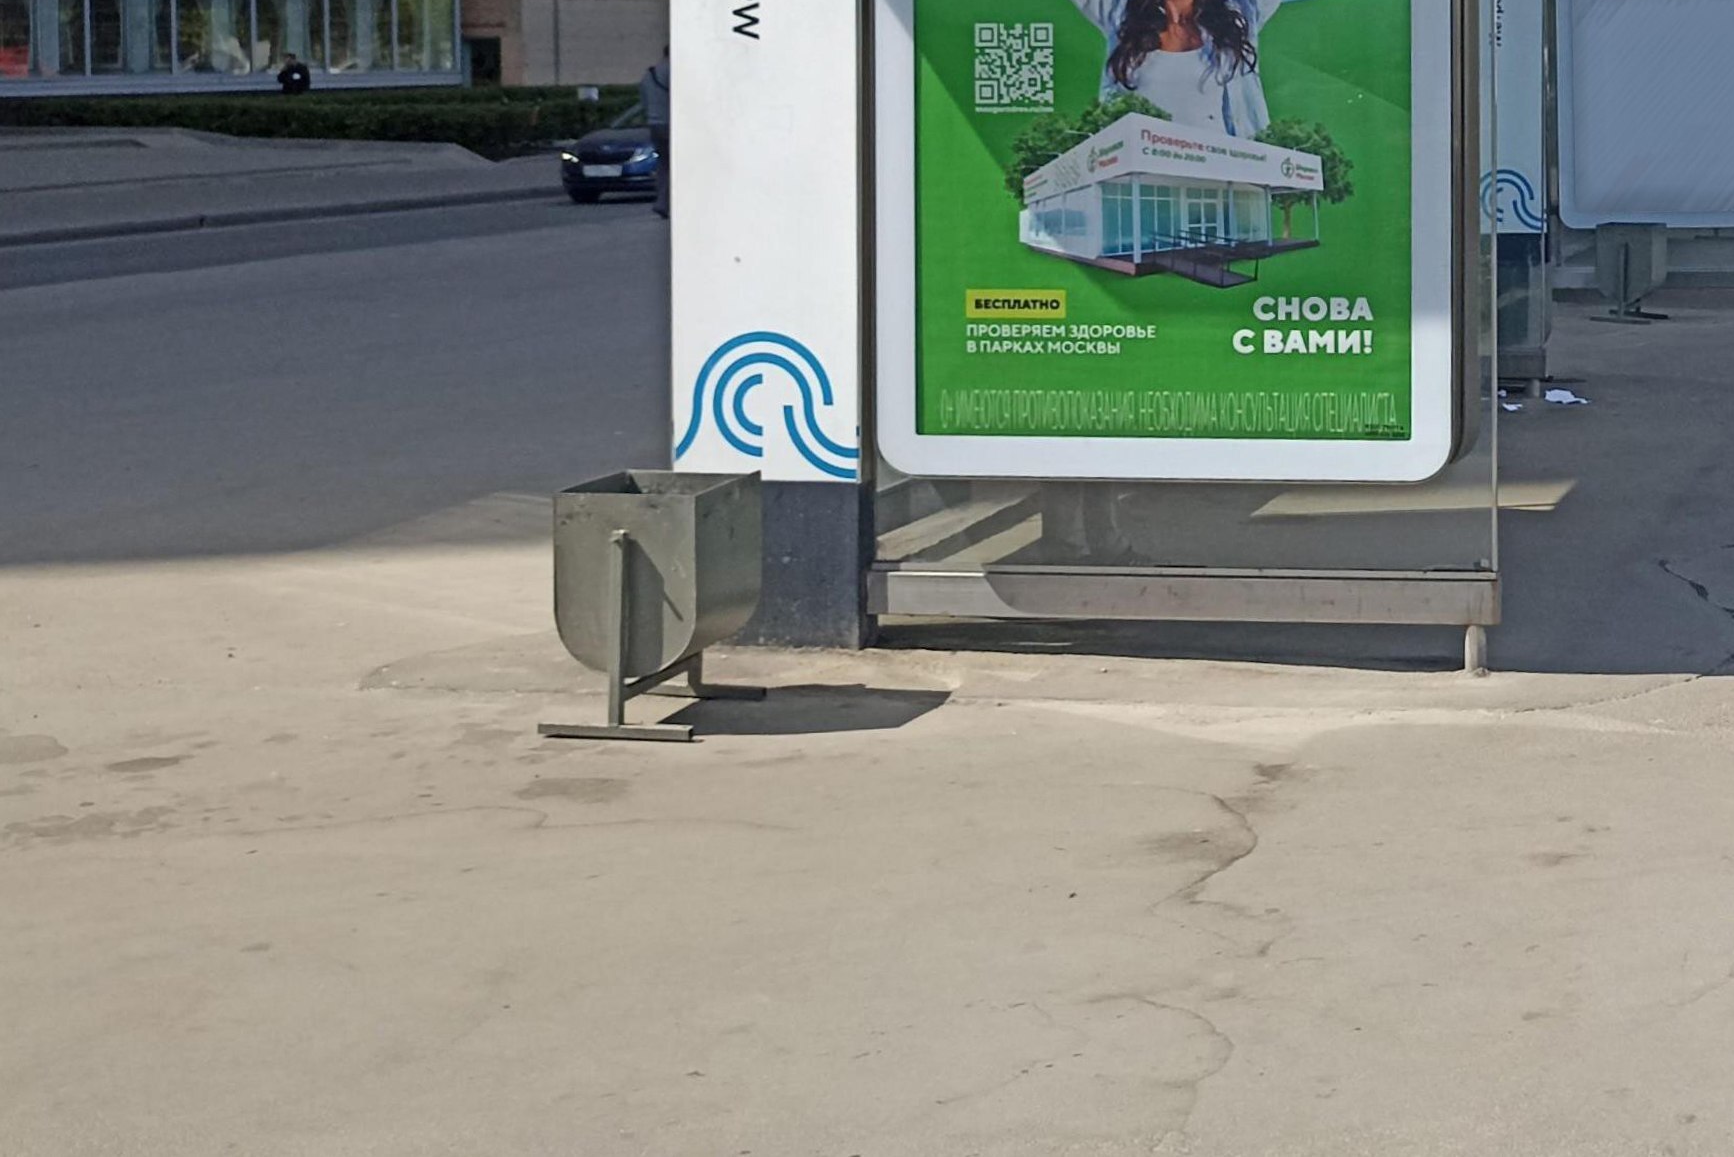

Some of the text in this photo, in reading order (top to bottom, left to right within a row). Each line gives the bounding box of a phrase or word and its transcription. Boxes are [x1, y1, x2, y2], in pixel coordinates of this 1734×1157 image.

[1140, 128, 1204, 152] Проверьте
[973, 298, 1060, 311] БЕСПЛАТНО
[1252, 296, 1373, 321] СНОВА
[966, 323, 1156, 339] ПРОВЕРЯЕМ ЗДОРОВЬЕ
[1232, 329, 1373, 354] С ВАМИ!
[966, 340, 1121, 354] В ПАРКАХ МОСКВЫ
[1139, 391, 1217, 431] НЕОБХОДИМА
[1220, 391, 1310, 431] КОНСУЛЬТАЦИЯ
